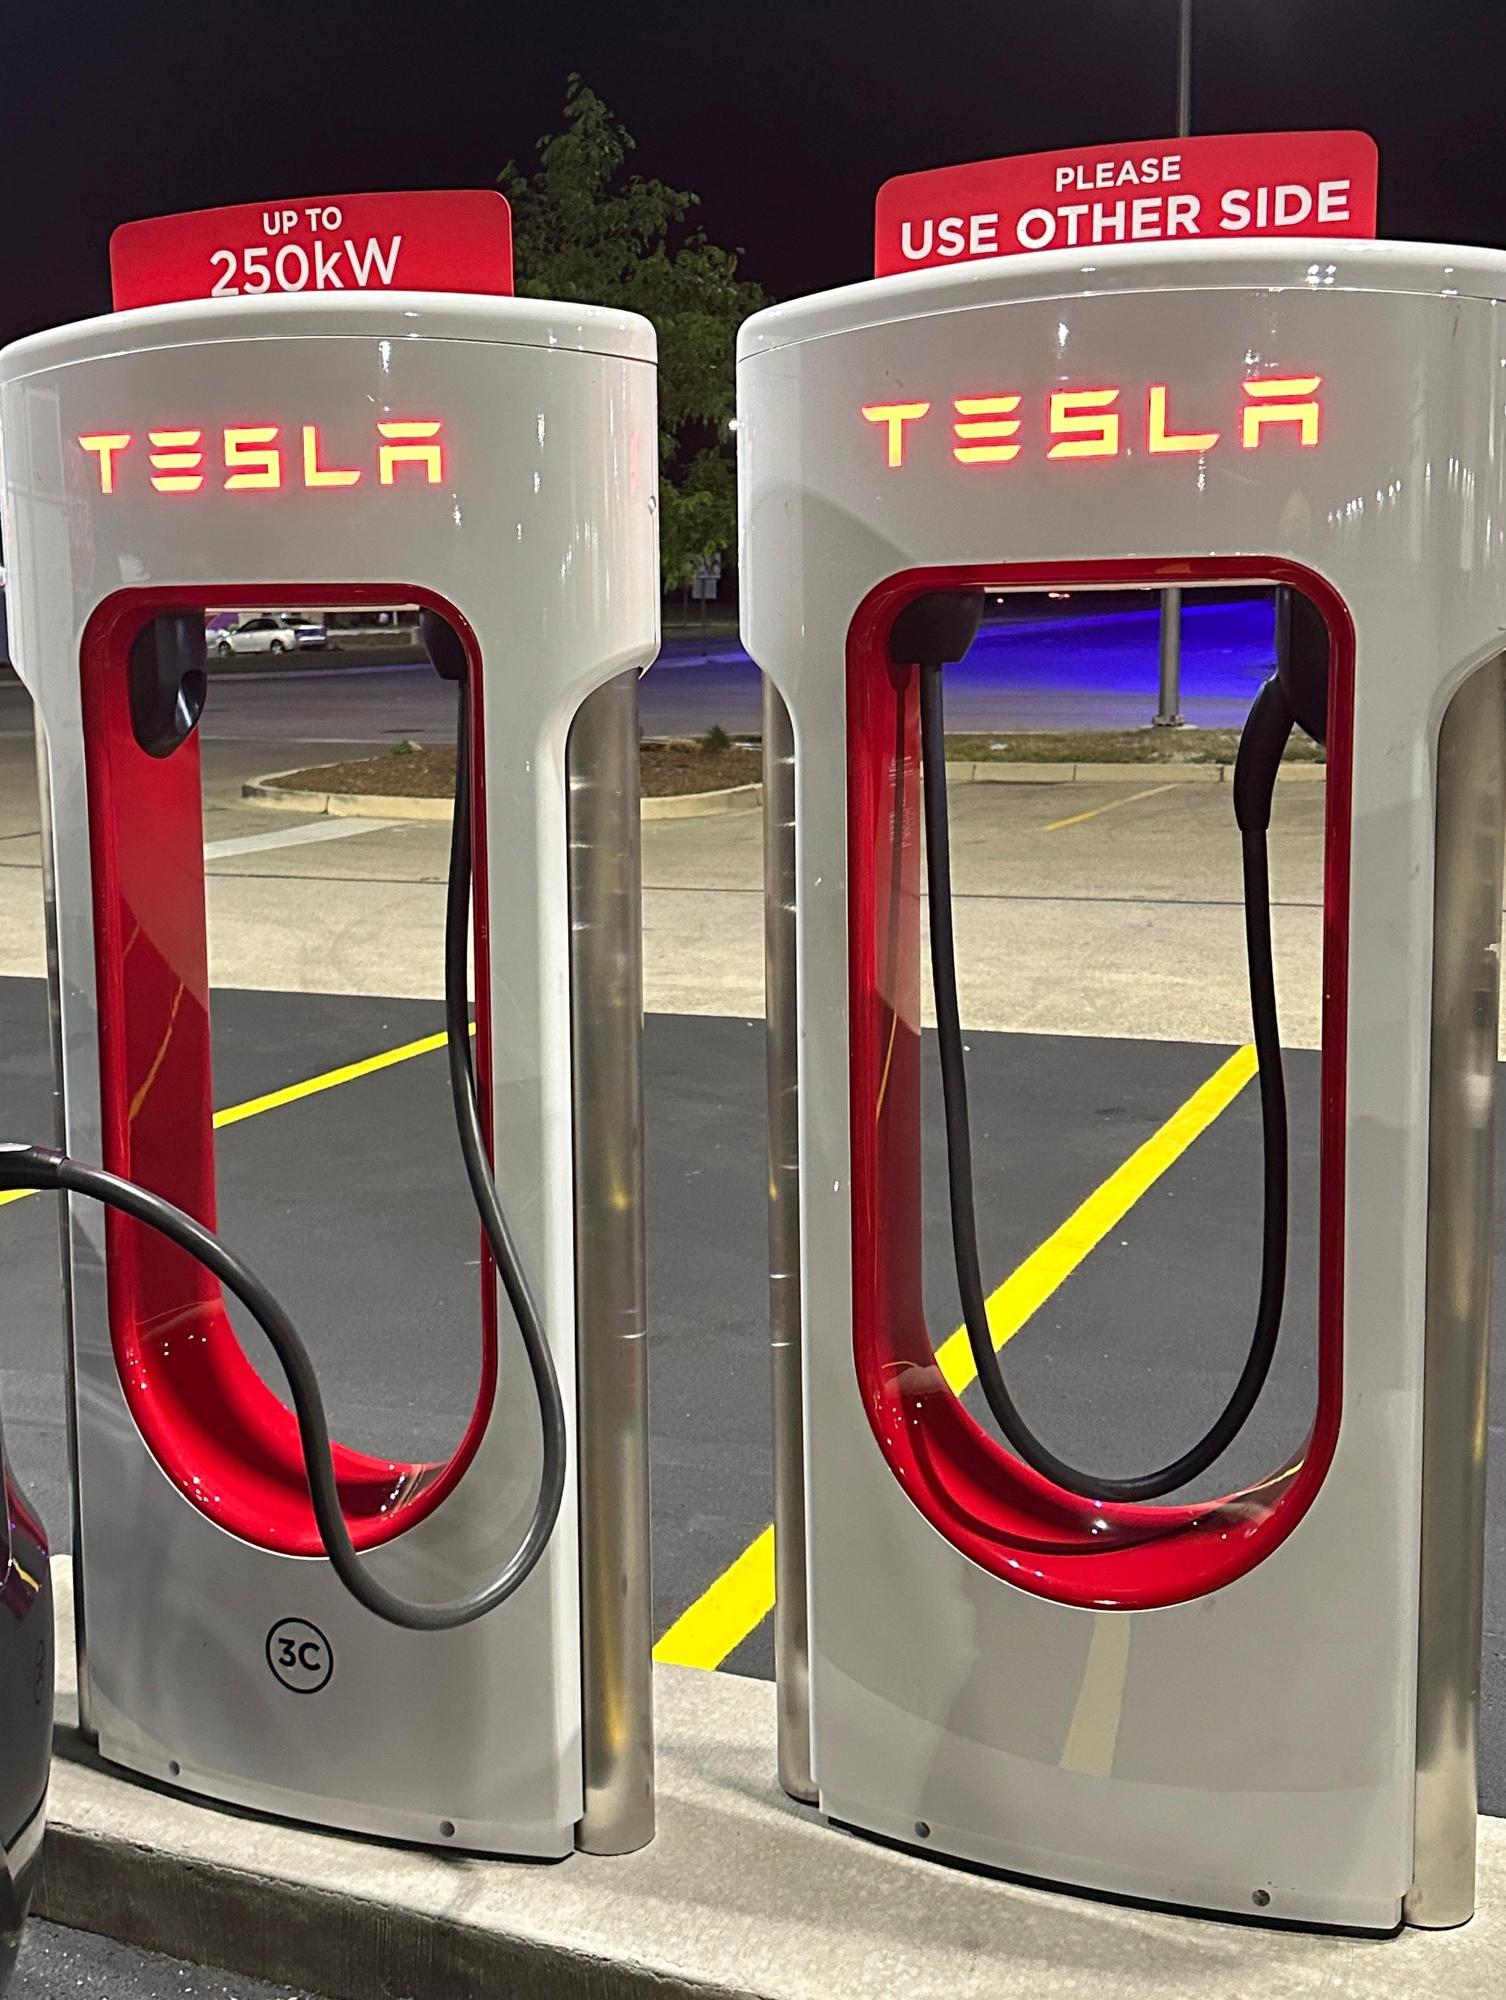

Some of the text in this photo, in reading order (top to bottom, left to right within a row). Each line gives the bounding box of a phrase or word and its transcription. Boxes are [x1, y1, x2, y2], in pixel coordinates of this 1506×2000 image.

[1055, 155, 1182, 192] PLEASE
[262, 206, 342, 235] UP TO
[901, 179, 1350, 260] USE OTHER SIDE
[210, 235, 402, 297] 250kW
[860, 375, 1323, 468] TESLA
[78, 419, 444, 495] TESLA
[277, 1637, 322, 1672] 3C
